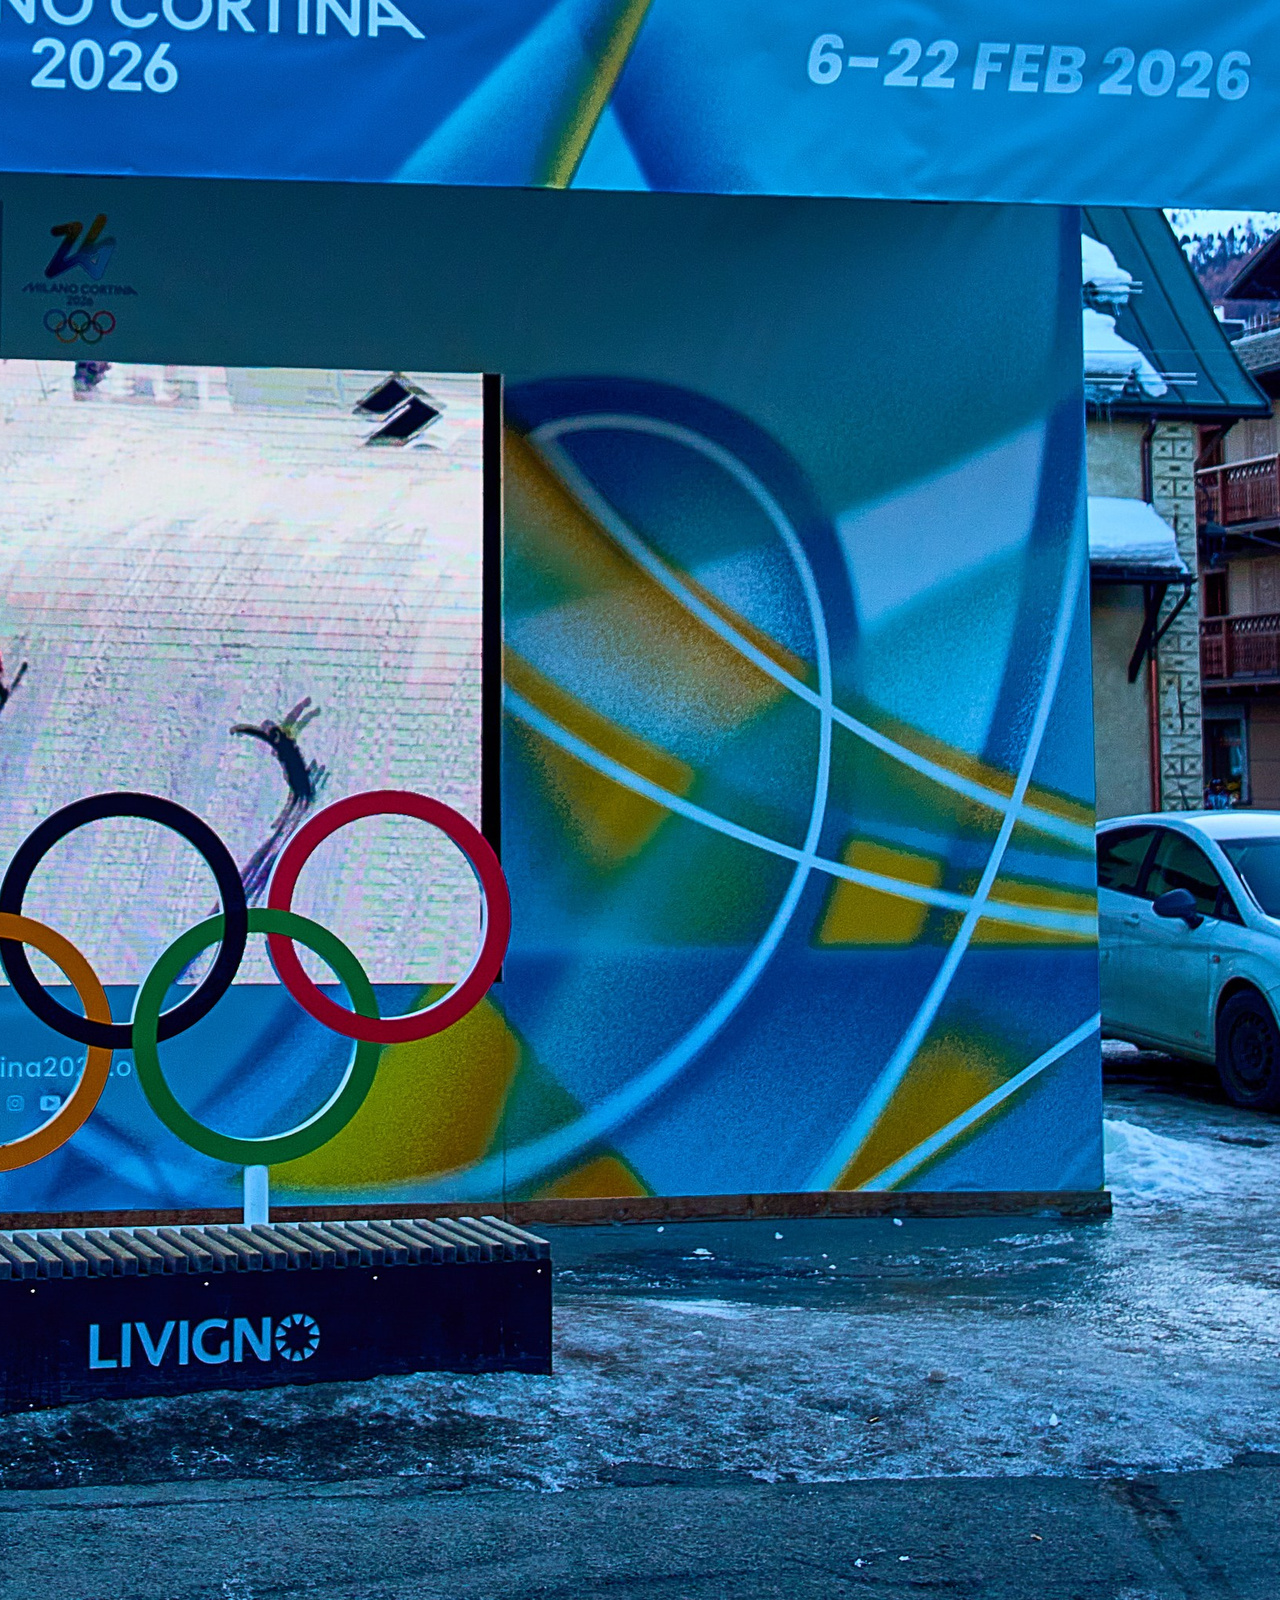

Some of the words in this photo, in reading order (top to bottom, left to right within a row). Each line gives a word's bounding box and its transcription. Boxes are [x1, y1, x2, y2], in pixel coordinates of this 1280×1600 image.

[30, 37, 179, 93] 2026
[971, 41, 1087, 94] FEB
[1097, 46, 1252, 101] 2026
[89, 1312, 321, 1370] LIVIGNO
